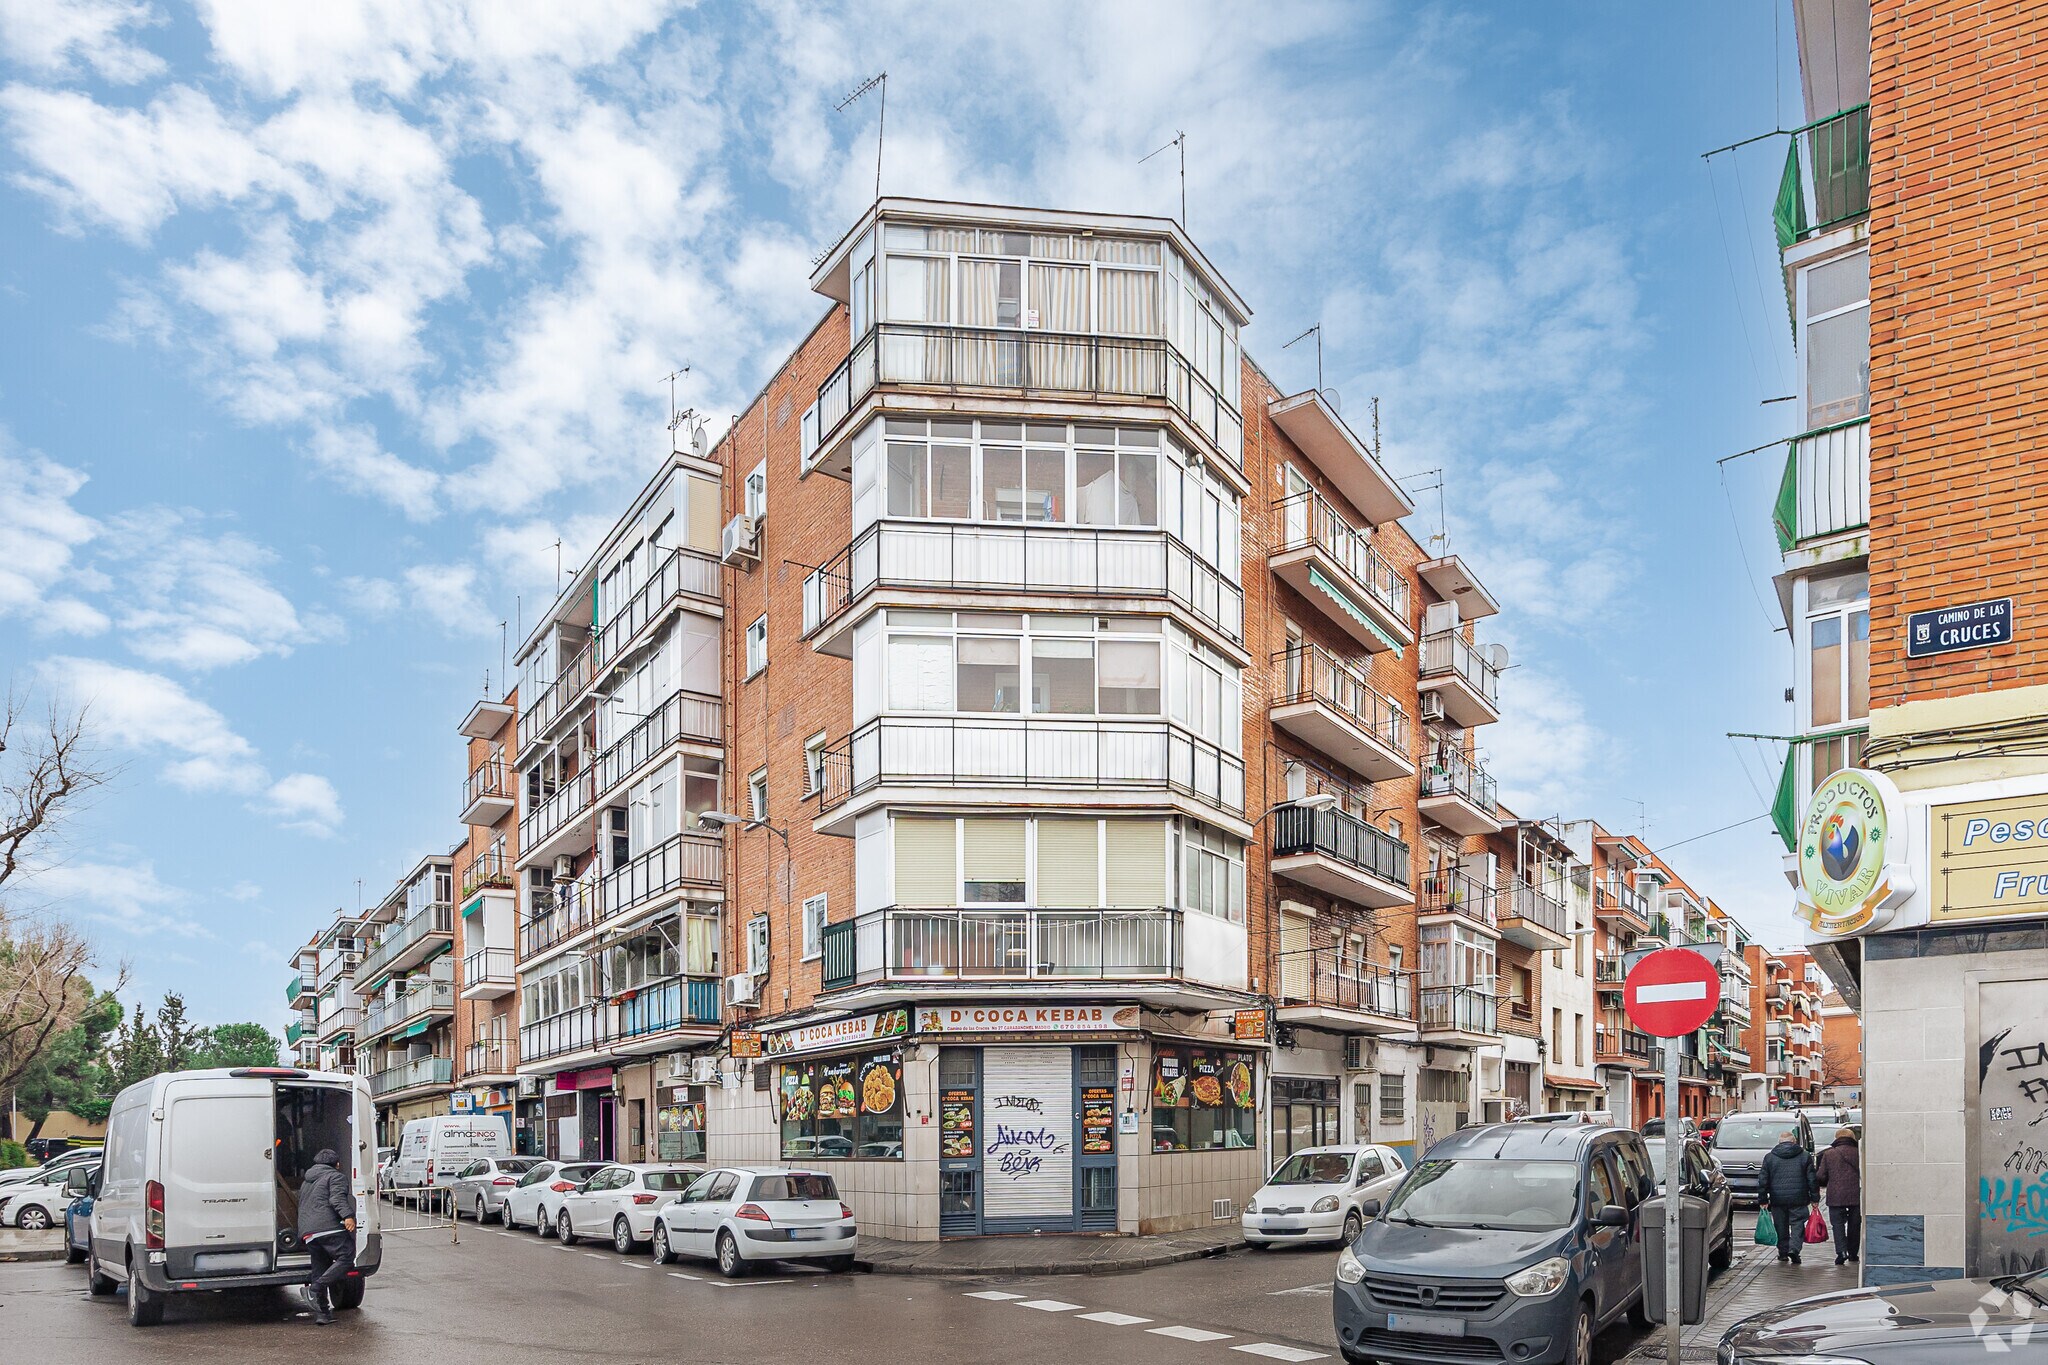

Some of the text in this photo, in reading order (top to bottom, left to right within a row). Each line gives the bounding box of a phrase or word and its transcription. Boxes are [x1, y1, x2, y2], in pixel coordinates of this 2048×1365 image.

[1938, 604, 2005, 625] CAMINO DE LAS
[1940, 621, 2001, 646] CRUCES
[1807, 781, 1878, 836] PRODUCTOS
[1815, 866, 1875, 906] VIVAR
[1036, 1008, 1103, 1022] KEBAB
[835, 1018, 867, 1036] KEBAB
[1237, 1054, 1253, 1063] PLATO
[1199, 1065, 1215, 1074] PIZZA
[785, 1075, 799, 1086] PIZZA
